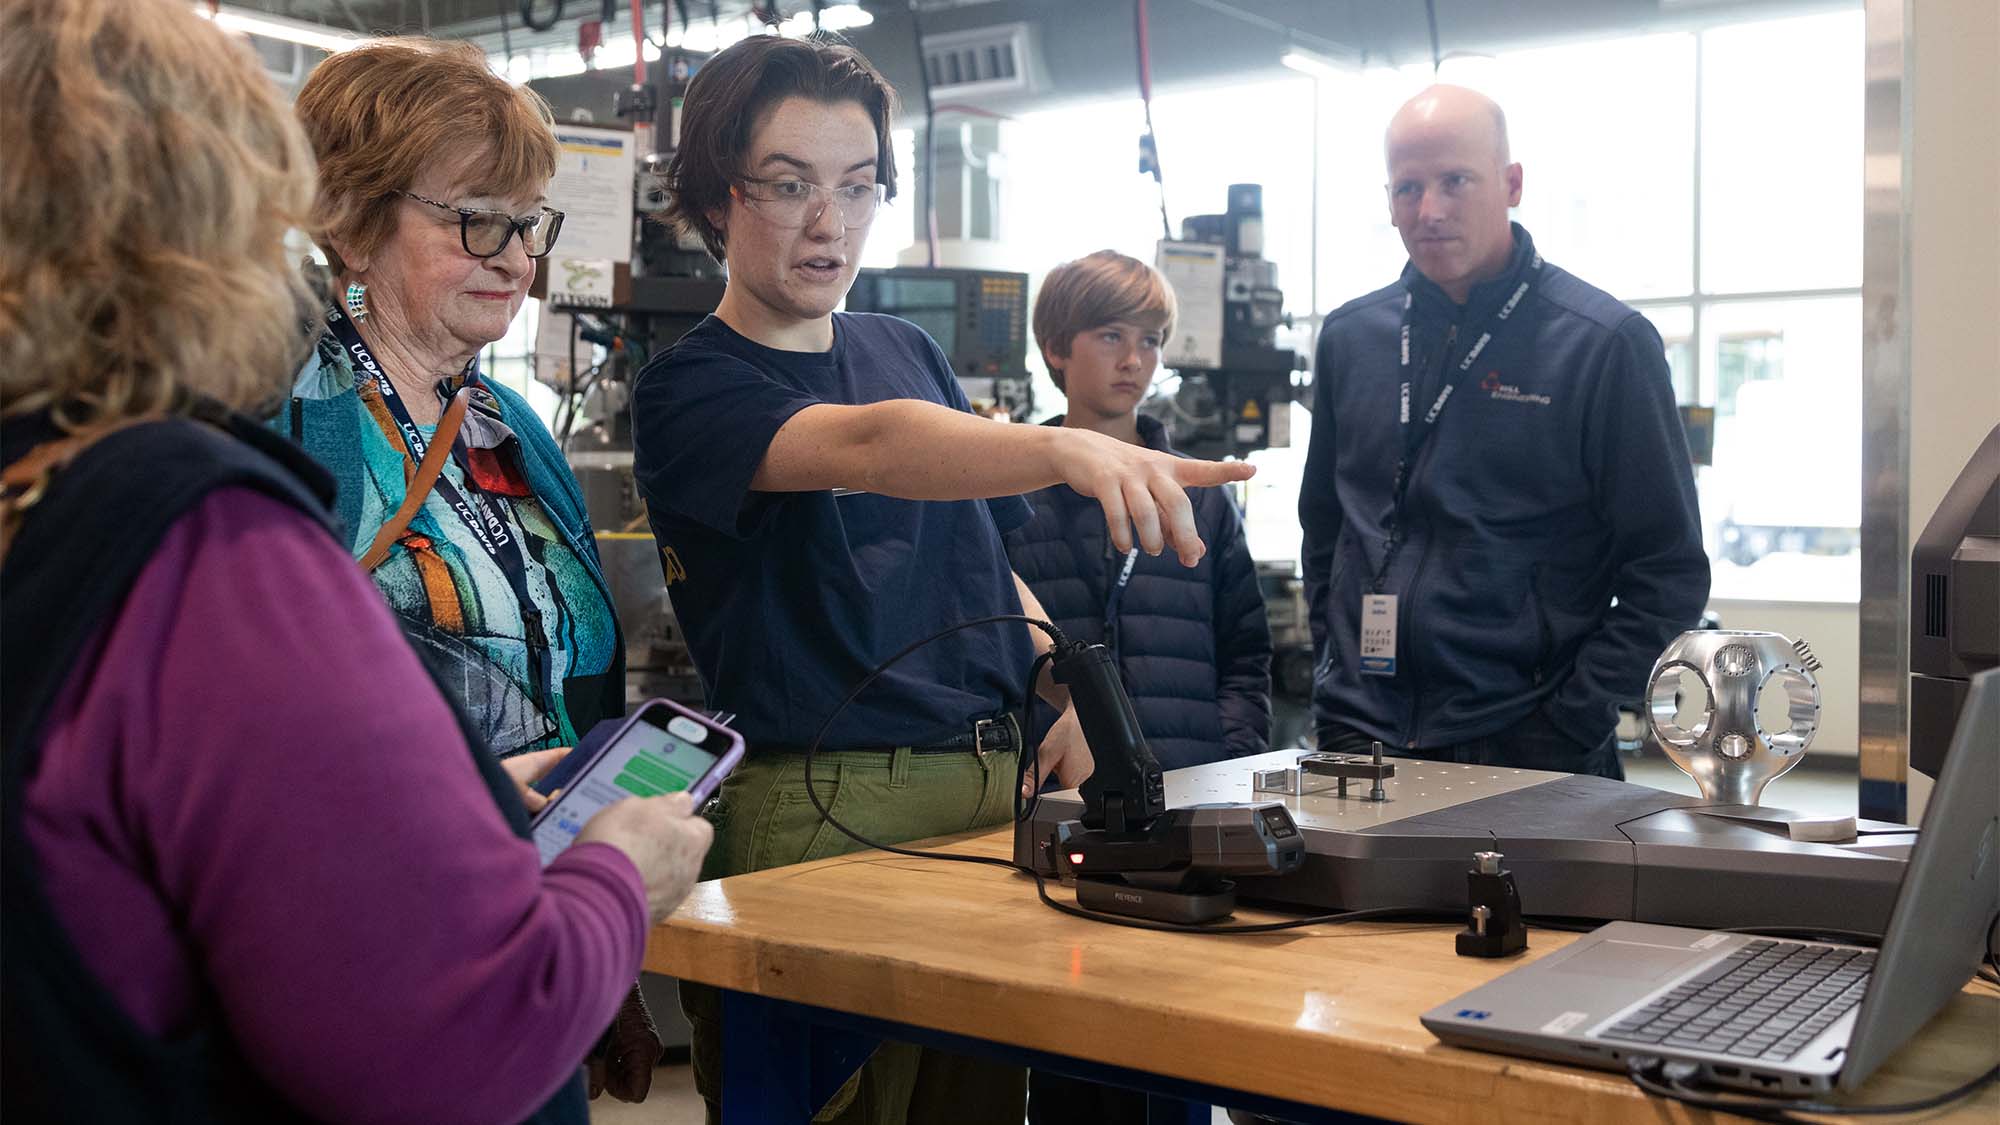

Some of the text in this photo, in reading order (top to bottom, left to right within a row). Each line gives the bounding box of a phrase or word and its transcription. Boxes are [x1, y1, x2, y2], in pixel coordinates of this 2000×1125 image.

[1498, 282, 1529, 320] UCDAVIS
[1401, 324, 1410, 366] UCDAVIS
[1459, 332, 1491, 371] UCDAVIS
[1400, 381, 1410, 424] UCDAVIS
[1424, 383, 1454, 424] UCDAVIS
